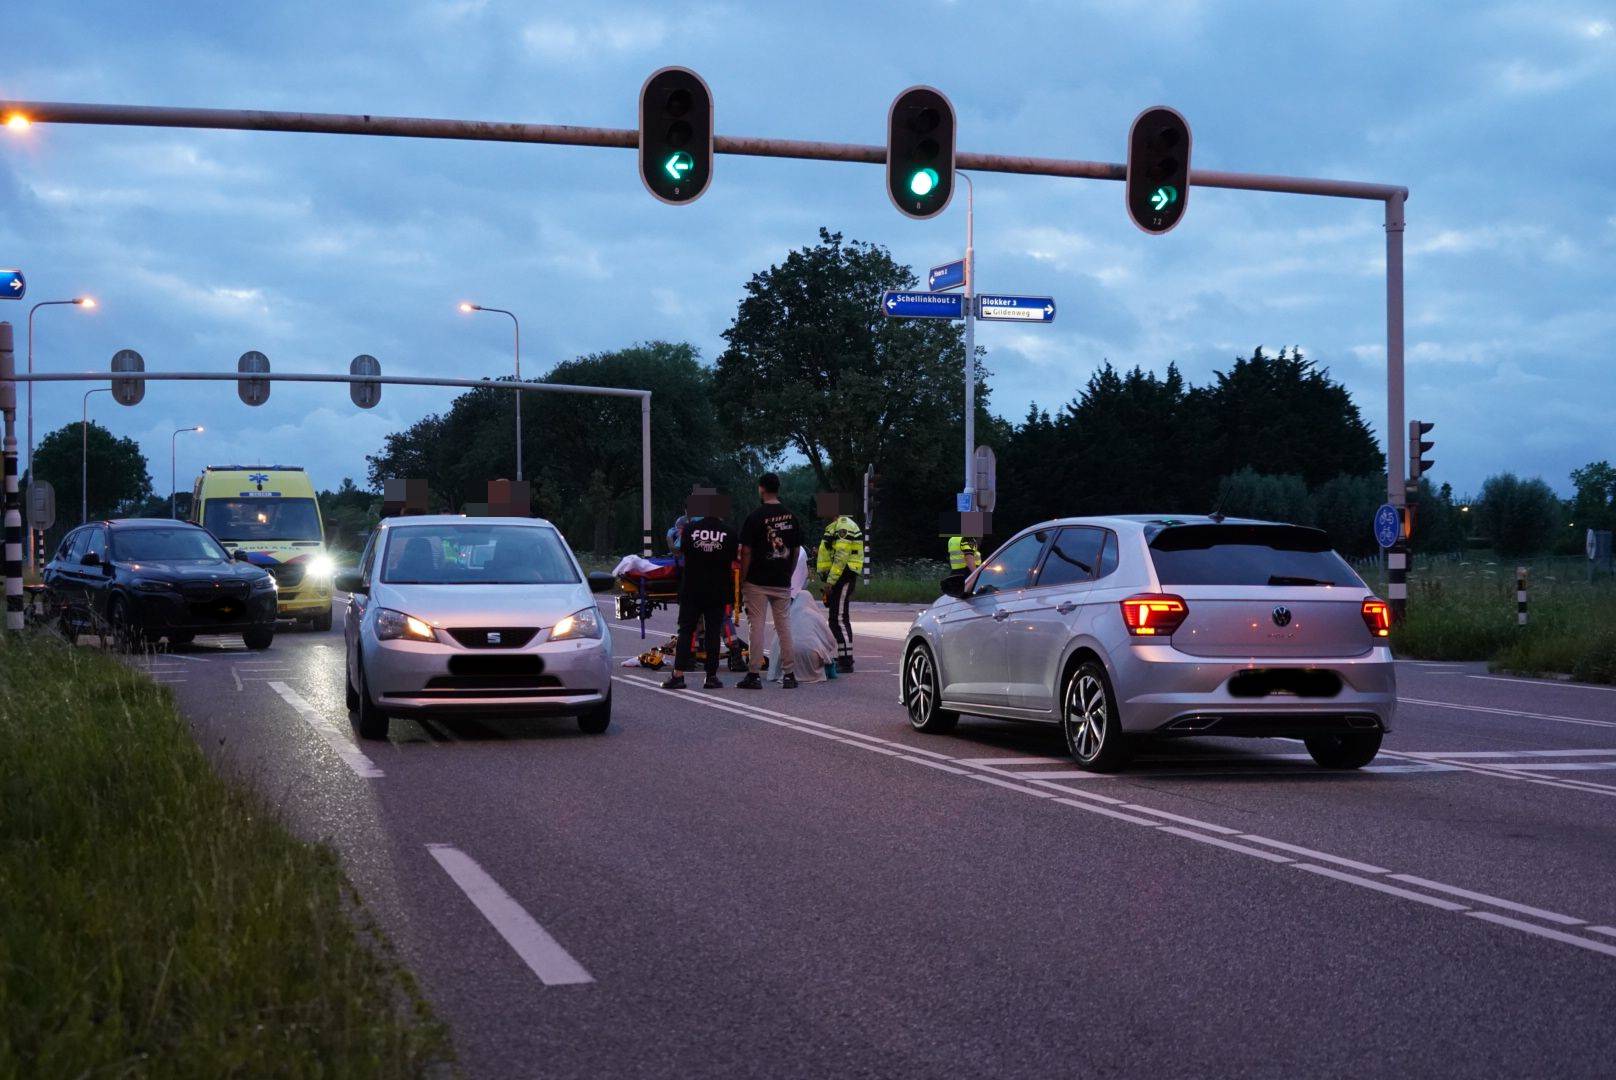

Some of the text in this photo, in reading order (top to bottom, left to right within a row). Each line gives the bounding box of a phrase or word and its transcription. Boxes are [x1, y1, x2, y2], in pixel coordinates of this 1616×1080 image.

[896, 295, 950, 304] Schellinkhout
[982, 297, 1011, 306] Blokker
[993, 309, 1031, 318] Gildenweg
